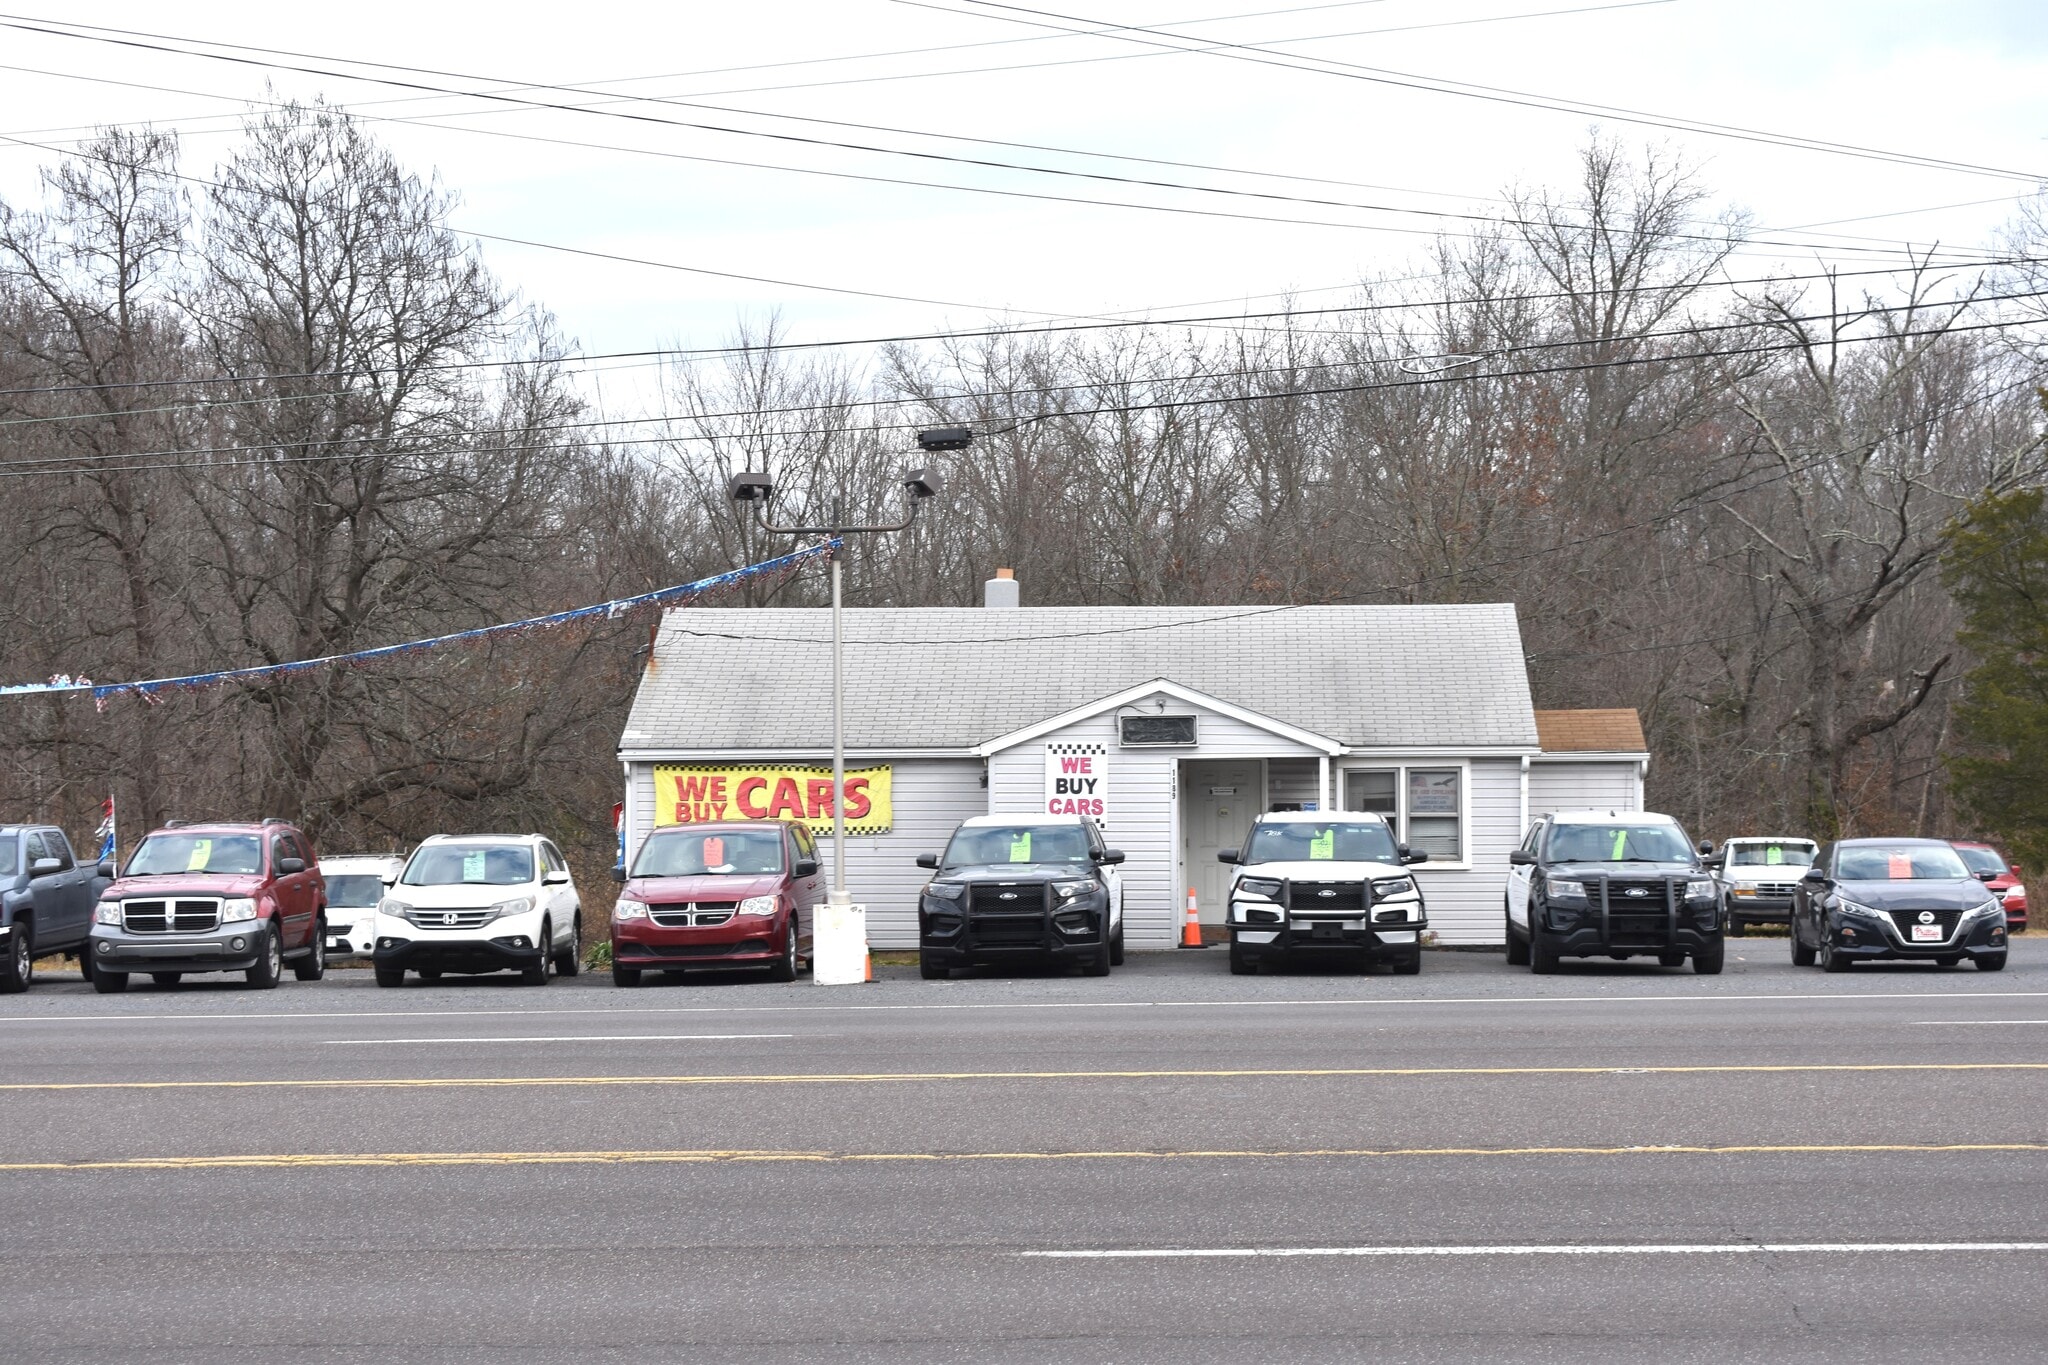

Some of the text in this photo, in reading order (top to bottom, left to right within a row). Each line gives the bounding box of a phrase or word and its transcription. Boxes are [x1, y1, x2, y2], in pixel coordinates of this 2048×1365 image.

[1060, 757, 1092, 774] WE
[674, 775, 728, 802] WE
[1055, 777, 1098, 795] BUY
[736, 776, 872, 820] CARS
[1048, 798, 1104, 816] CARS
[675, 802, 728, 824] BUY
